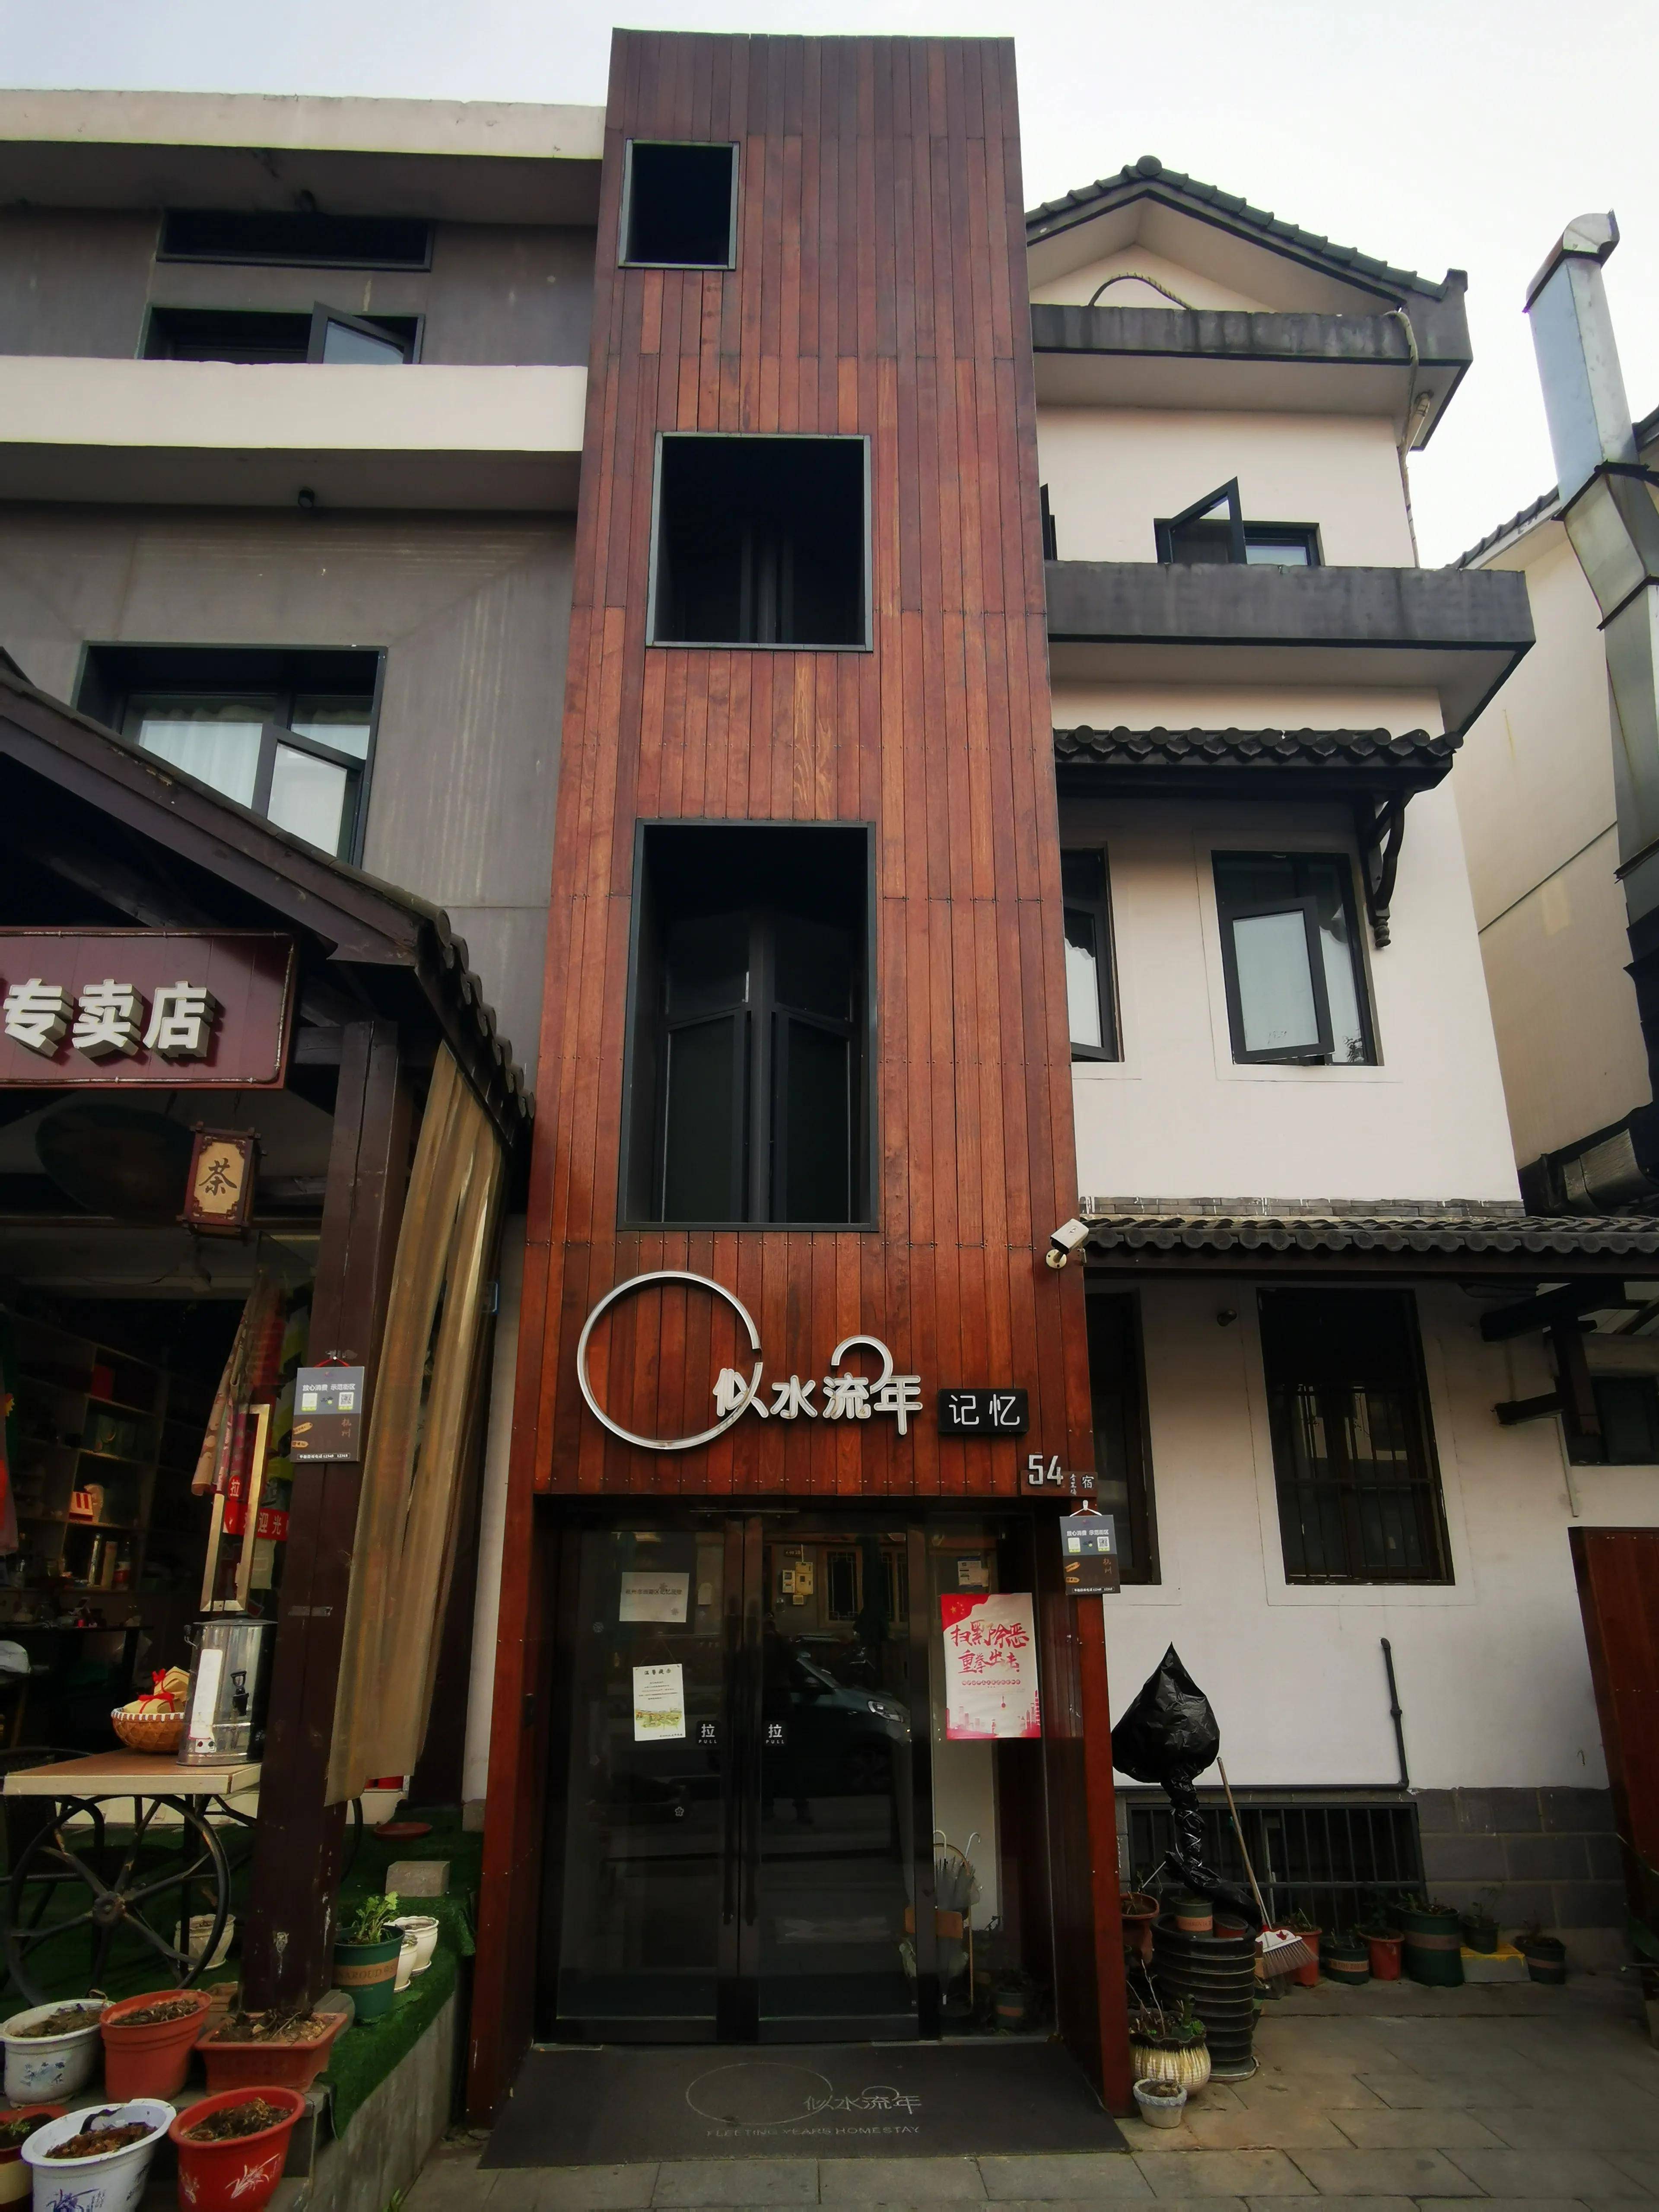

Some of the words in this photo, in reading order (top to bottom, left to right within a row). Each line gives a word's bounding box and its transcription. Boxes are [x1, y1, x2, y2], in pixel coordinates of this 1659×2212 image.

[3, 979, 214, 1058] 专卖店
[199, 1158, 238, 1195] 茶
[948, 1394, 1020, 1427] 记忆
[1029, 1455, 1064, 1485] 54
[1082, 1475, 1094, 1489] 宿
[230, 1479, 241, 1497] 拉
[950, 1619, 1030, 1648] 扫黑除恶
[701, 1724, 715, 1737] 拉
[768, 1724, 782, 1738] 拉
[804, 2085, 922, 2115] 似水流年
